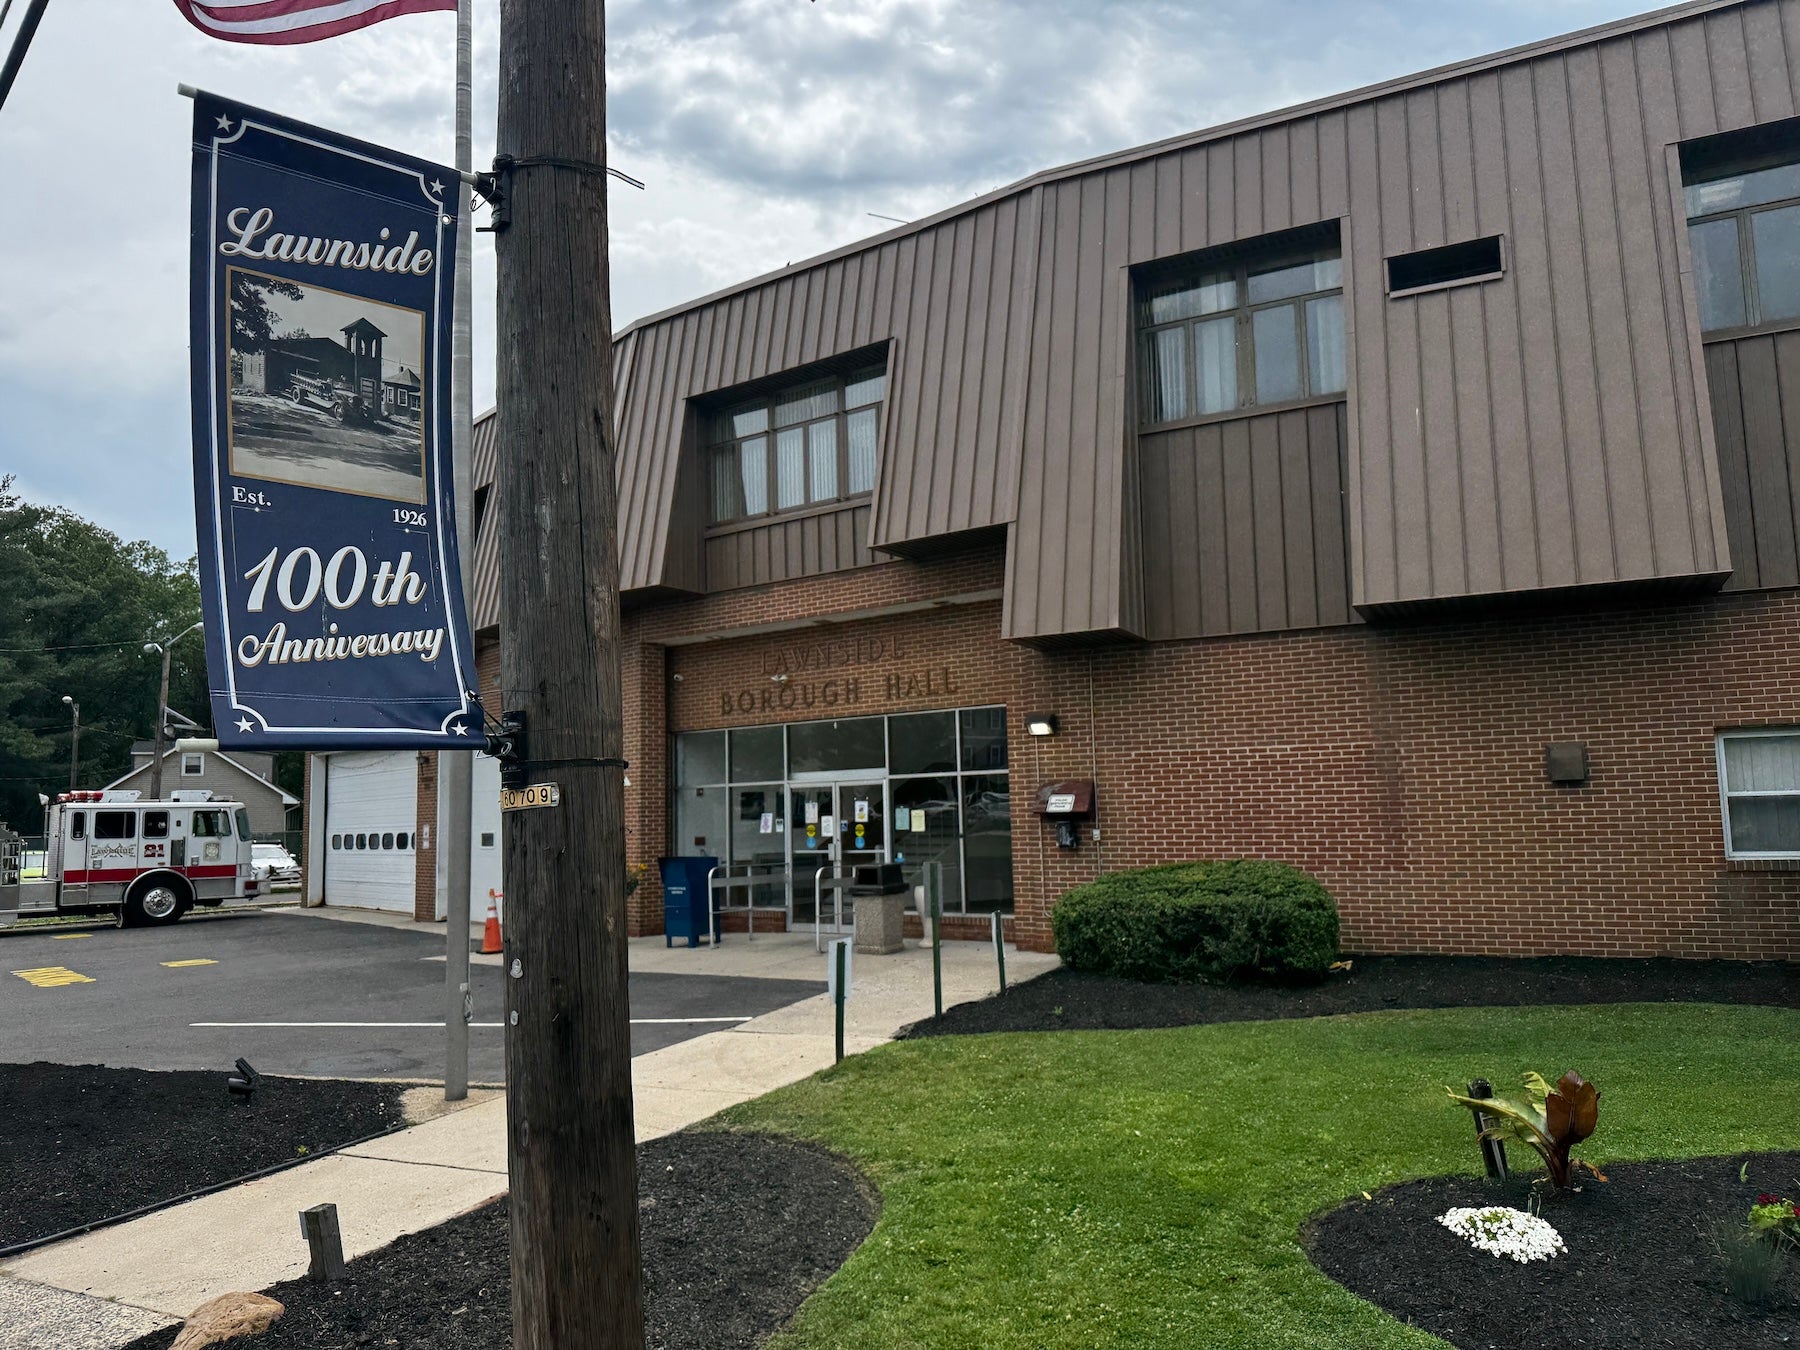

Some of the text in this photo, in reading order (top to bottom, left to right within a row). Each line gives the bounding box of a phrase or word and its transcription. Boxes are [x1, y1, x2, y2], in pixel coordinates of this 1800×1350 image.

[219, 207, 434, 275] Lawnside
[231, 486, 272, 507] Est.
[392, 508, 428, 527] 1926
[244, 545, 428, 613] 100th
[237, 622, 445, 668] Anniversary
[760, 634, 905, 675] LAWNSIDE
[720, 667, 959, 716] BOROUGH HALL
